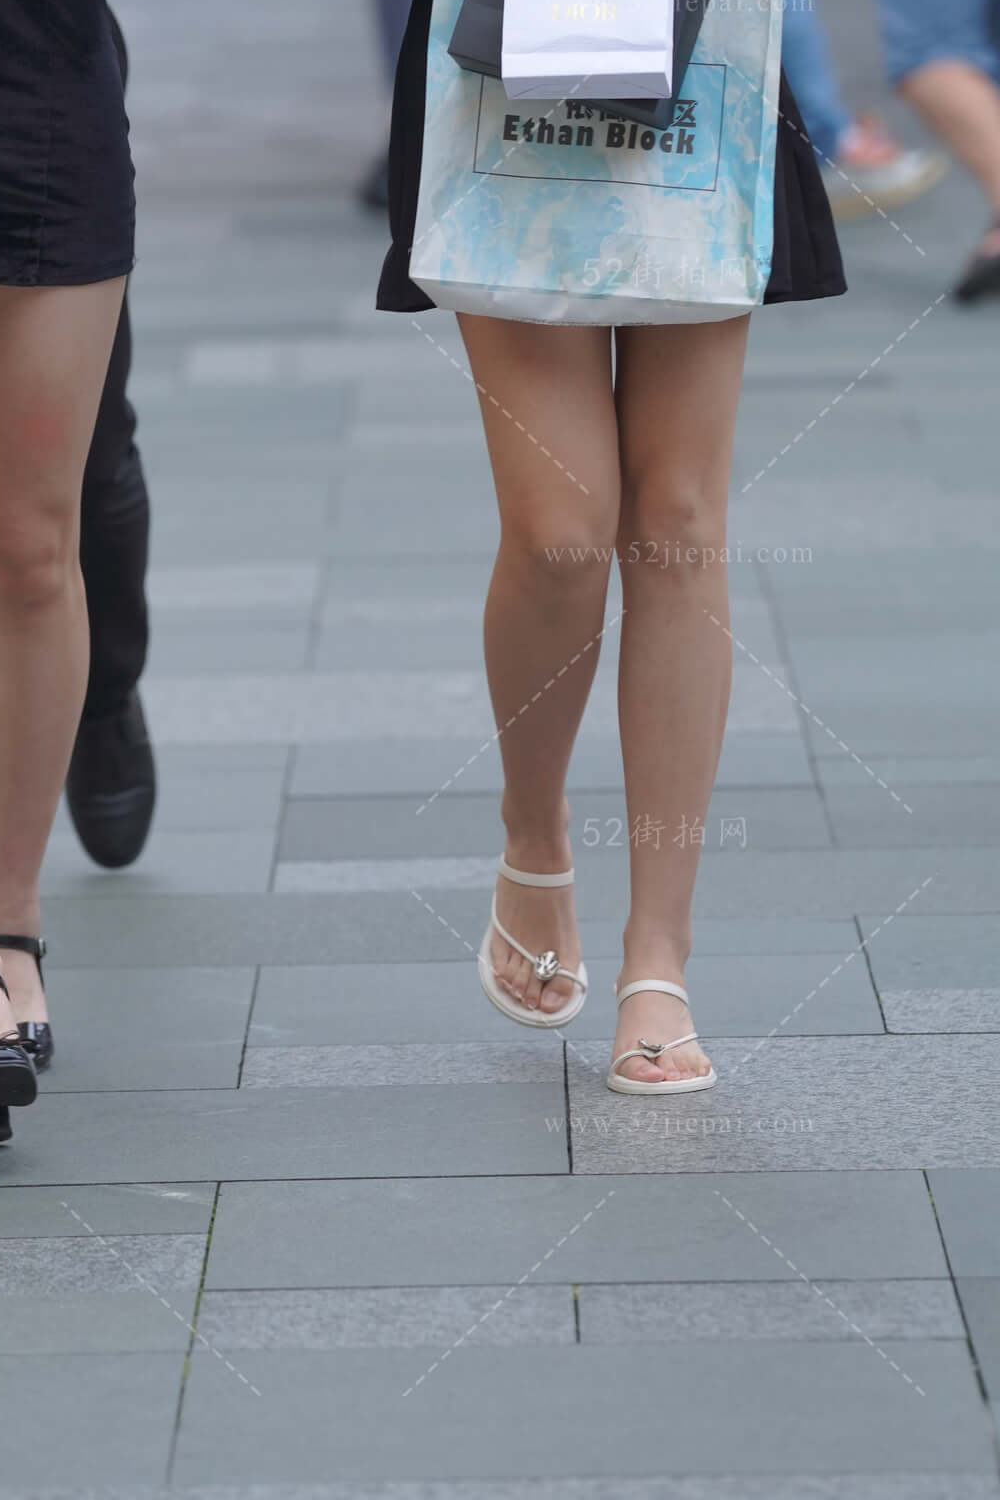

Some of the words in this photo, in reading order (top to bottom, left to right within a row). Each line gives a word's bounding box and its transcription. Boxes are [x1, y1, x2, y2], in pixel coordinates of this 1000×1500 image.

[552, 2, 617, 22] DIOR
[503, 114, 595, 148] Ethan
[605, 121, 697, 156] Block
